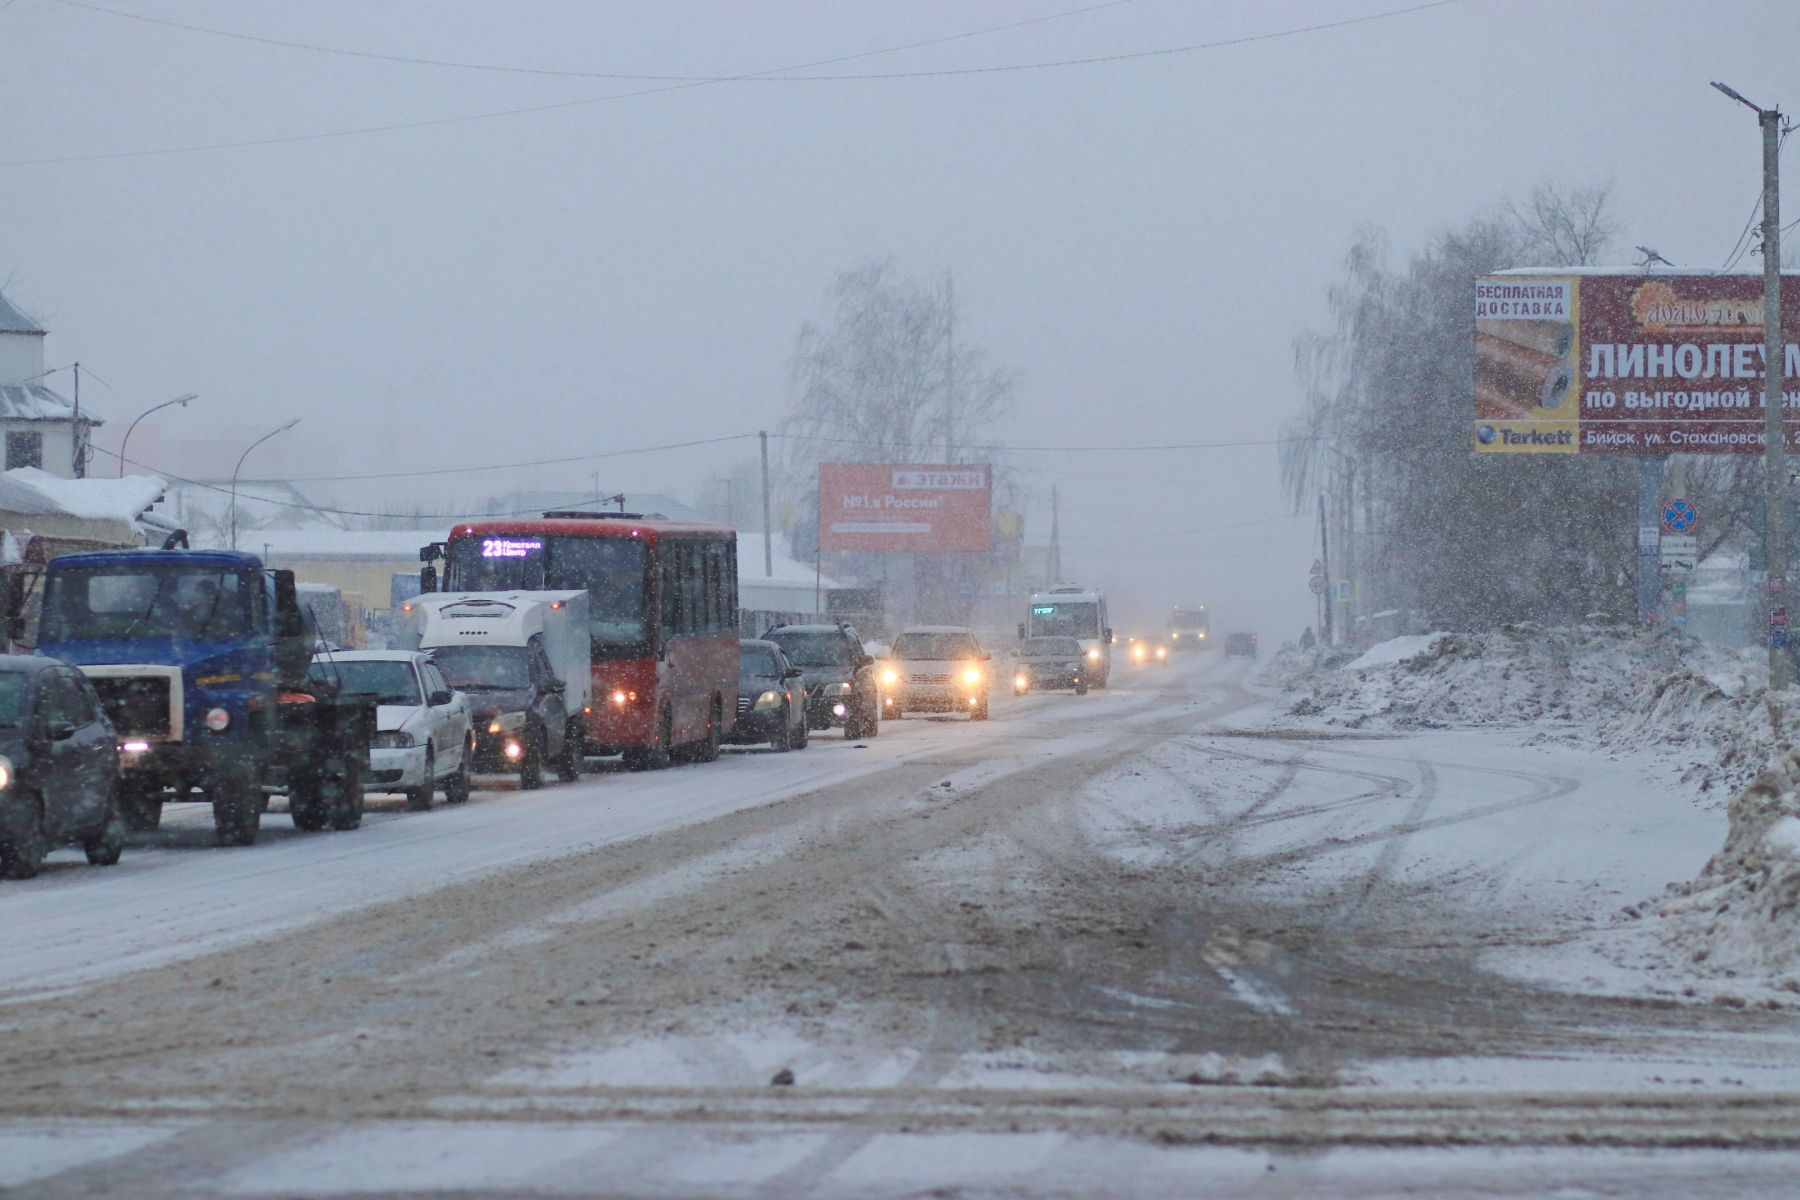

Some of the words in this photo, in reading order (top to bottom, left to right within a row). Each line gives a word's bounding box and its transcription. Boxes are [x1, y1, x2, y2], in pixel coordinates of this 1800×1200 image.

[1476, 285, 1563, 299] БЕСПЛАТНАЯ
[1476, 302, 1563, 317] ДОСТАВКА
[1586, 393, 1615, 408] по
[1625, 388, 1750, 412] выгодной
[1500, 428, 1572, 446] Tarkett
[1586, 431, 1639, 446] Бийск,
[1644, 433, 1664, 447] ул.
[1669, 430, 1790, 447] Стахановск,
[483, 540, 502, 557] 23
